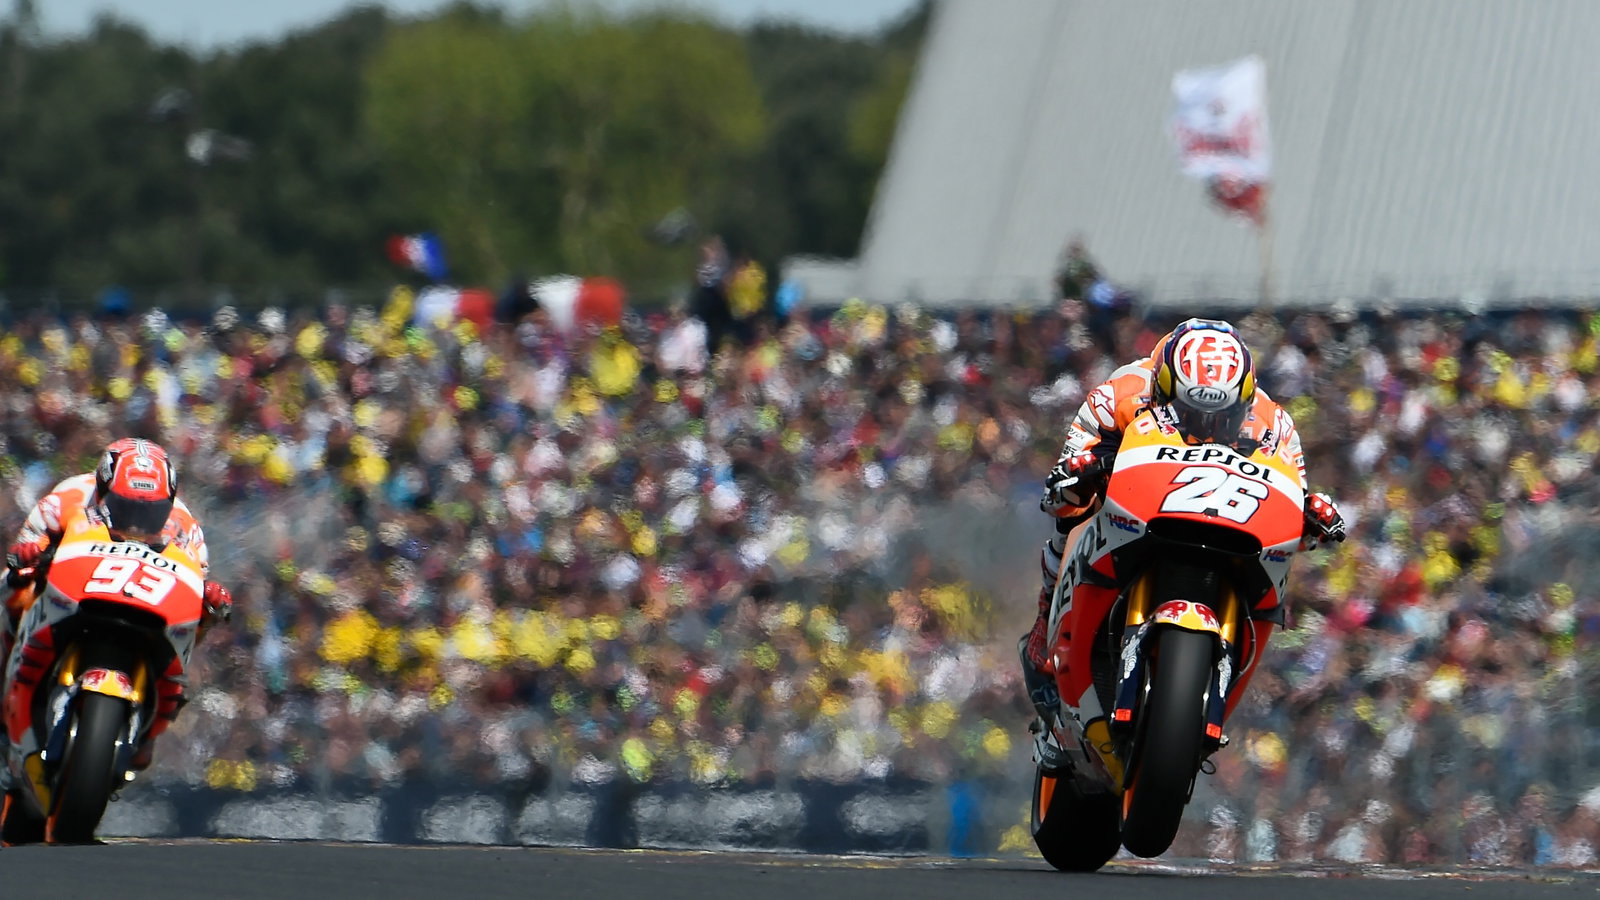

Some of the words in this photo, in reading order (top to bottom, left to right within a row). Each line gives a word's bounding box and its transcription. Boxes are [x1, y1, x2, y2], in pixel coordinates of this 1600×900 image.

[1155, 446, 1273, 484] REPSOL
[1159, 466, 1270, 525] 26
[90, 543, 178, 573] REPSOL
[84, 557, 177, 606] 93
